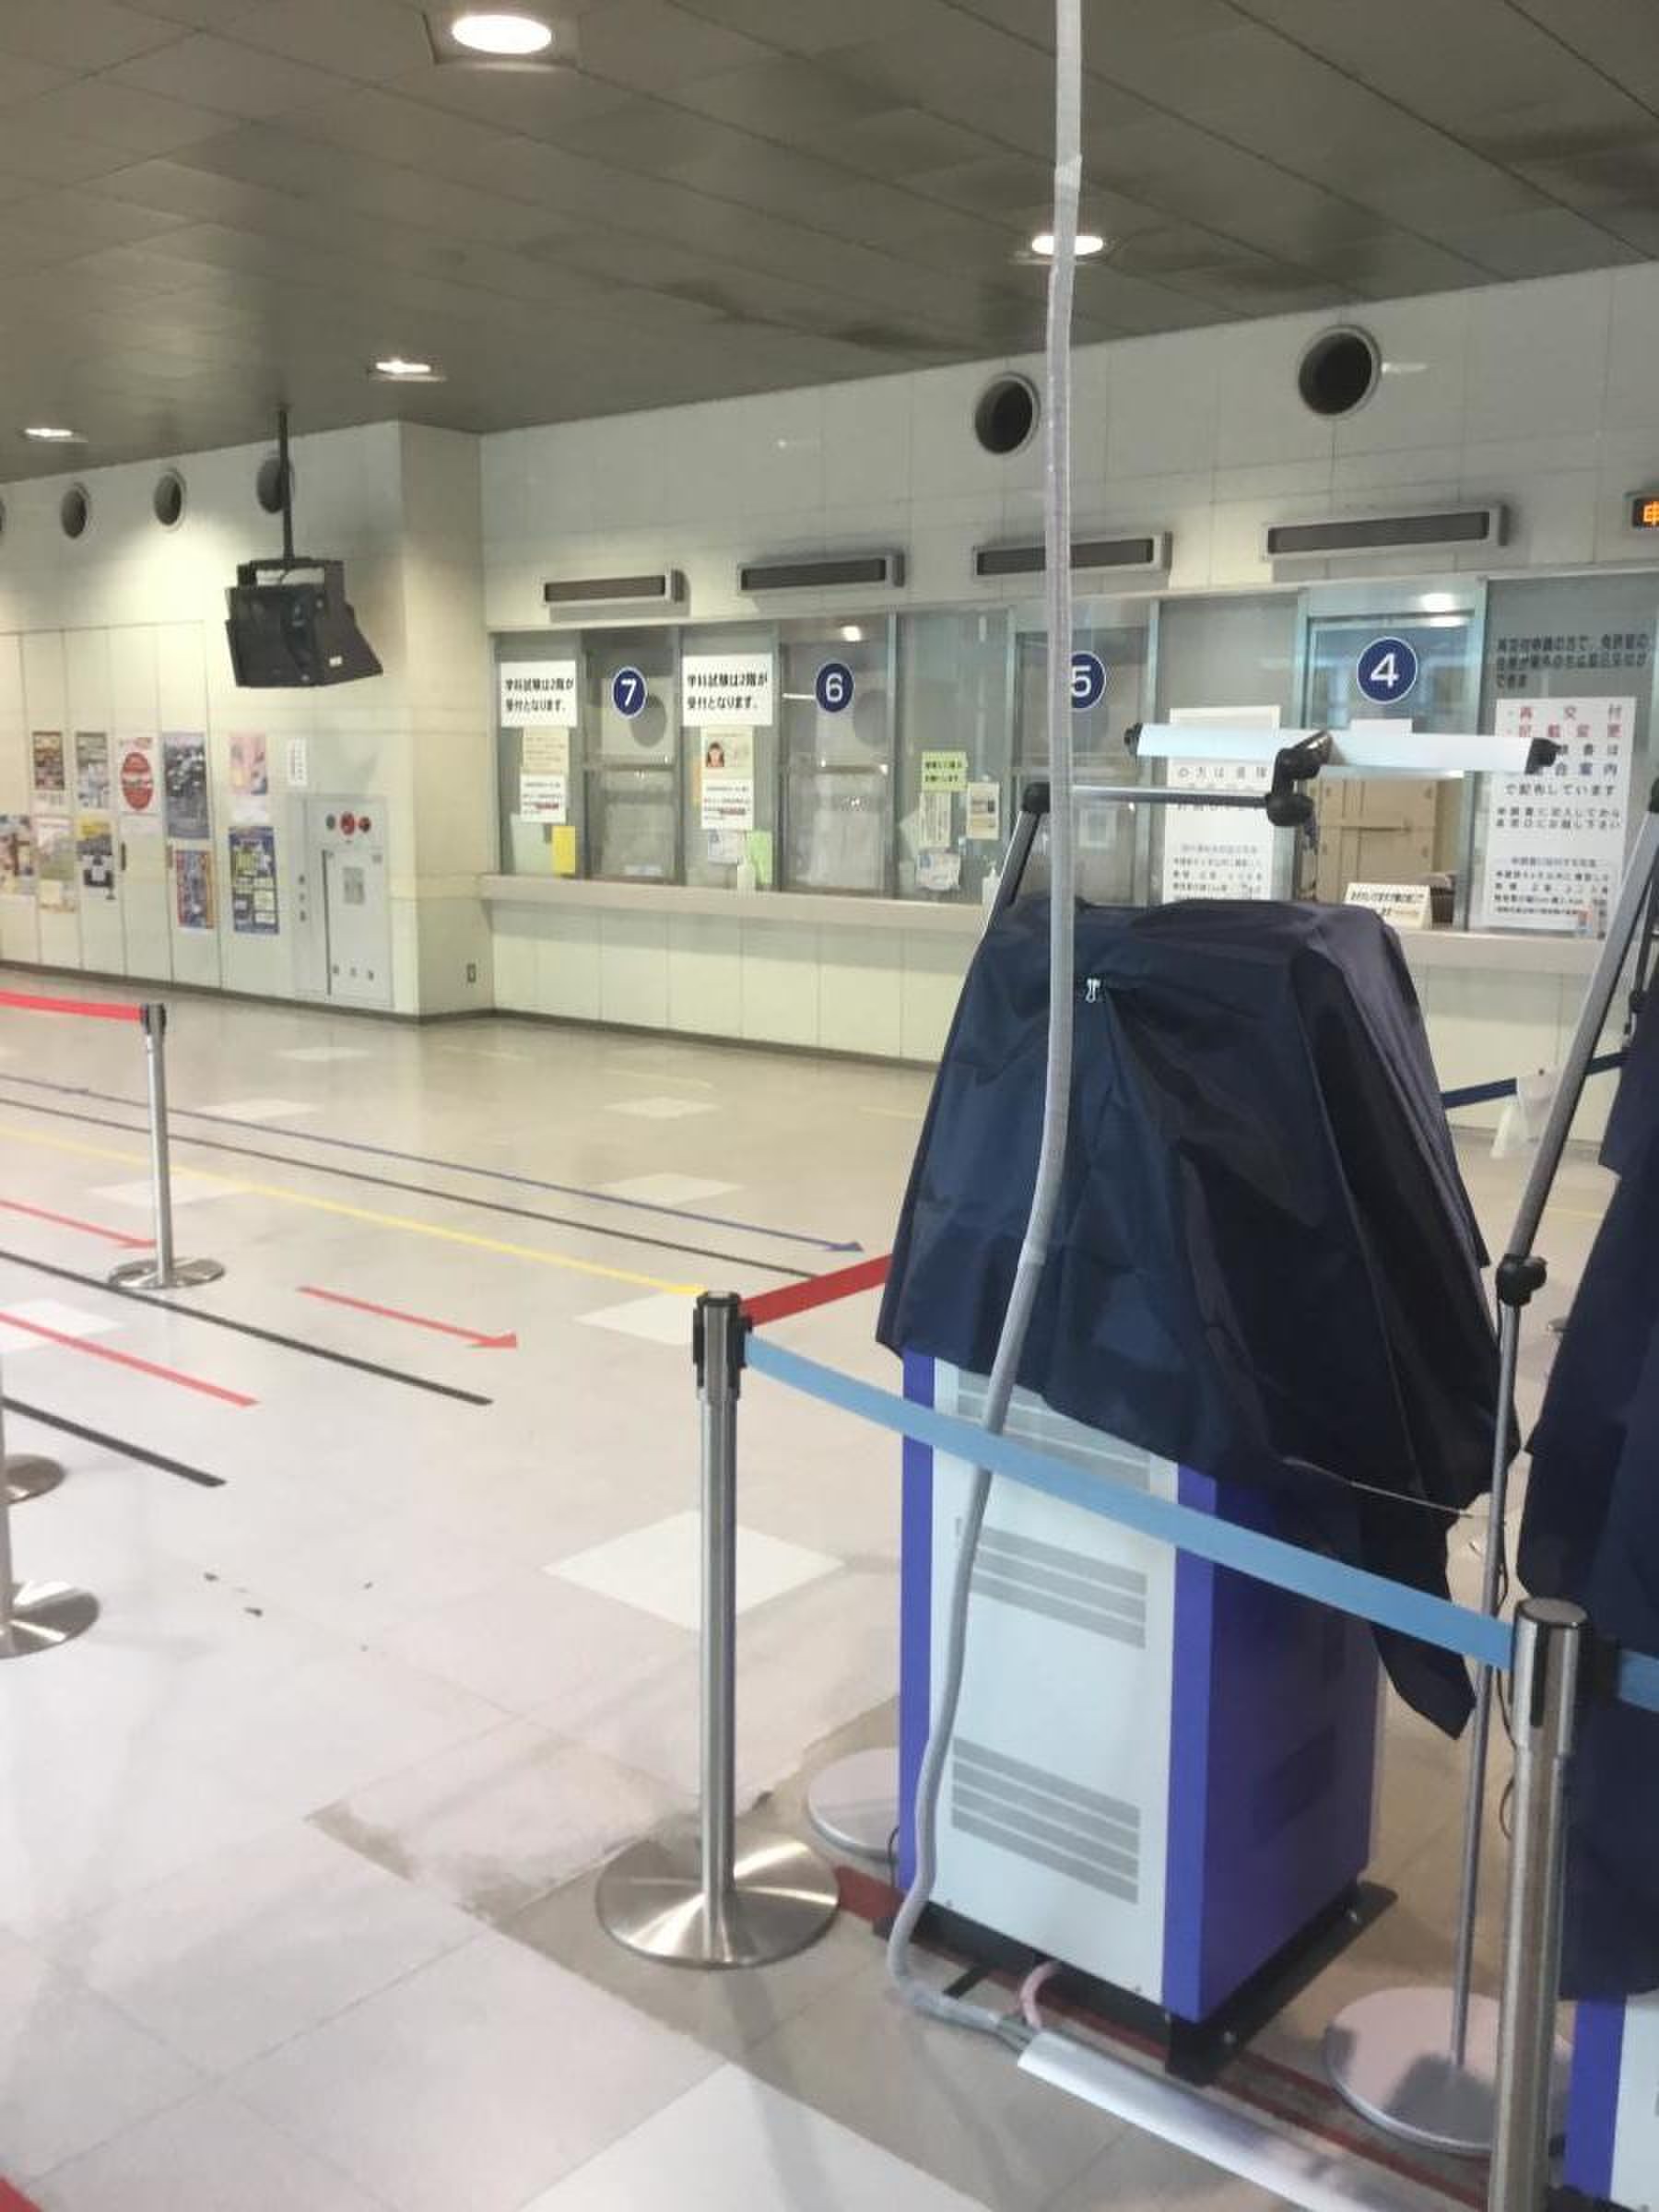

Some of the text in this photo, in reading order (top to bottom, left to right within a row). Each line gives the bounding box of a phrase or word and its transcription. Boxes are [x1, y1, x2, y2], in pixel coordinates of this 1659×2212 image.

[1071, 665, 1091, 698] 5
[1370, 653, 1399, 688] 4
[621, 678, 637, 706] 7
[824, 673, 844, 703] 6
